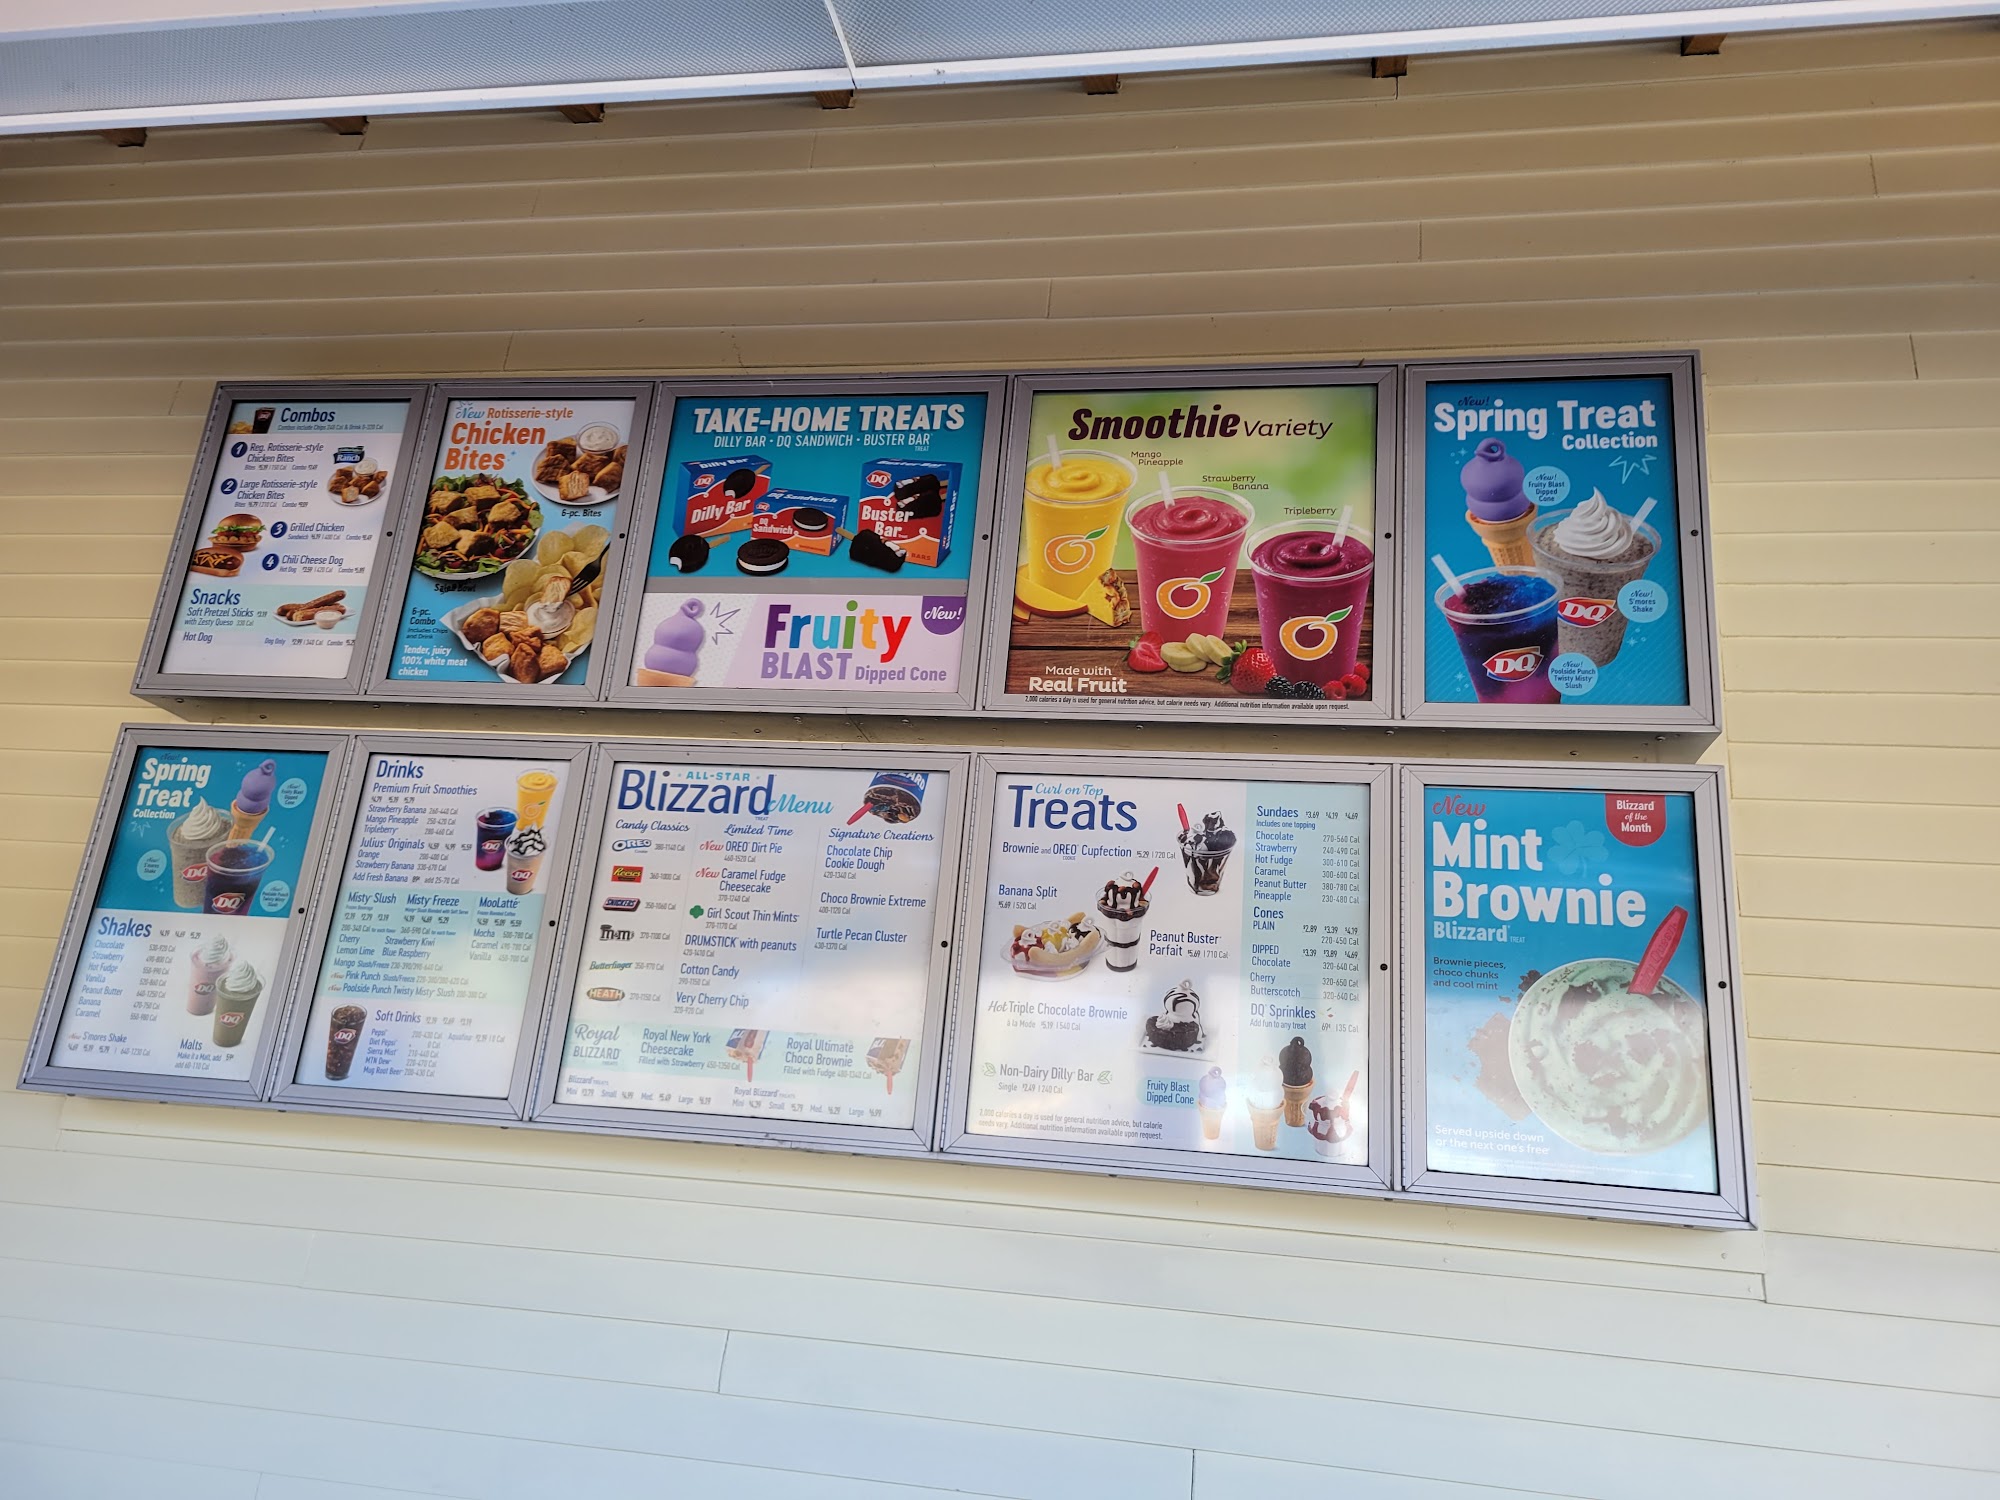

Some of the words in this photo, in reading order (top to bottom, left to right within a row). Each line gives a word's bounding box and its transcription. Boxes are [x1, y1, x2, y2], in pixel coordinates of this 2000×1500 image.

[281, 408, 335, 422] Combos
[456, 407, 485, 419] New
[487, 407, 573, 421] Rotisserie-style
[693, 405, 851, 433] TAKE-HOME
[859, 404, 965, 431] TREATS
[1434, 399, 1547, 440] Spring
[1557, 400, 1656, 430] Treat
[1068, 403, 1241, 440] Smoothie
[1244, 420, 1334, 440] Variety
[452, 421, 546, 445] Chicken
[714, 436, 740, 448] DILLY
[745, 436, 765, 448] BAR
[777, 436, 791, 448] DQ
[795, 435, 852, 447] SANDWICH
[864, 434, 905, 446] BUSTER
[908, 434, 930, 445] BAR
[1562, 431, 1658, 450] Collection
[250, 443, 266, 453] Reg.
[267, 443, 323, 453] Rotisserie-style
[444, 446, 505, 470] Bites
[700, 461, 726, 469] Dilly
[1138, 459, 1183, 467] Pineapple
[1202, 475, 1256, 483] Strawberry
[691, 505, 723, 524] Dilly
[725, 499, 751, 514] Bar
[862, 505, 914, 523] Buster
[1284, 507, 1337, 516] Tripleberry
[290, 523, 314, 531] Grilled
[316, 524, 344, 532] Chicken
[191, 588, 240, 605] Snacks
[187, 607, 202, 617] Soft
[204, 608, 230, 617] Pretzel
[232, 608, 253, 617] Sticks
[183, 632, 196, 642] Hot
[198, 632, 213, 643] Dog
[764, 600, 912, 663] Fruity
[761, 652, 852, 680] BLAST
[855, 666, 906, 684] Dipped
[909, 667, 947, 681] Cone
[1045, 666, 1078, 676] Made
[1083, 665, 1112, 676] with
[1029, 677, 1073, 692] Real
[1077, 677, 1126, 692] Fruit
[142, 757, 211, 788] Spring
[376, 760, 424, 779] Drinks
[136, 783, 194, 807] Treat
[373, 783, 409, 793] Premium
[412, 784, 431, 794] Fruit
[433, 785, 478, 796] Smoothies
[618, 770, 775, 815] Blizzard
[767, 794, 834, 815] Menu
[1036, 783, 1062, 794] Curl
[1065, 787, 1081, 795] on
[1083, 784, 1103, 798] Top
[368, 805, 401, 815] Strawberry
[403, 806, 426, 814] Banana
[1008, 785, 1138, 832] Treats
[1432, 795, 1486, 816] New
[1616, 800, 1654, 810] Blizzard
[133, 809, 175, 819] Collection
[1257, 806, 1298, 818] Sundaes
[1306, 811, 1319, 819] $3.69
[616, 819, 648, 833] Candy
[651, 821, 690, 832] Classics
[1621, 822, 1652, 832] Month
[829, 828, 881, 841] Signature
[883, 830, 935, 841] Creations
[1256, 831, 1294, 841] Chocolate
[1323, 835, 1348, 843] 270-560
[700, 840, 724, 850] New
[726, 841, 747, 852] OREO
[752, 842, 768, 852] Dirt
[769, 843, 782, 854] Pie
[1003, 842, 1039, 854] Brownie
[1053, 844, 1076, 854] OREO
[1082, 845, 1132, 858] Cupfection
[1255, 843, 1297, 854] Strawberry
[1323, 847, 1348, 855] 240-490
[1432, 819, 1542, 871] Mint
[827, 845, 871, 857] Chocolate
[874, 847, 893, 860] Chip
[825, 858, 854, 869] Cookie
[857, 859, 885, 872] Dough
[1254, 867, 1286, 876] Caramel
[721, 868, 757, 879] Caramel
[760, 870, 786, 883] Fudge
[720, 881, 771, 893] Cheesecake
[999, 884, 1033, 896] Banana
[1036, 886, 1057, 898] Split
[1254, 879, 1281, 889] Peanut
[1283, 880, 1307, 889] Butter
[407, 894, 430, 907] Misty
[432, 895, 459, 906] Freeze
[820, 892, 848, 904] Choco
[851, 894, 886, 906] Brownie
[888, 895, 926, 907] Extreme
[1254, 890, 1291, 901] Pineapple
[1433, 870, 1646, 928] Brownie
[1253, 907, 1284, 919] Cones
[98, 917, 152, 938] Shakes
[816, 928, 843, 939] Turtle
[845, 929, 872, 941] Pecan
[875, 930, 907, 942] Cluster
[1150, 930, 1185, 942] Peanut
[1187, 931, 1218, 944] Buster
[685, 935, 736, 948] DRUMSTICK
[740, 939, 758, 949] with
[760, 940, 797, 952] peanuts
[1150, 944, 1182, 956] Parfait
[1252, 944, 1279, 954] DIPPED
[681, 963, 710, 975] Cotton
[712, 965, 740, 979] Candy
[1434, 968, 1463, 978] choco
[1466, 969, 1498, 979] chunks
[82, 985, 104, 994] Peanut
[104, 987, 123, 996] Butter
[676, 992, 696, 1004] Very
[698, 993, 727, 1007] Cherry
[729, 994, 749, 1008] Chip
[375, 1010, 394, 1022] Soft
[396, 1011, 421, 1023] Drinks
[988, 1001, 1008, 1013] Hot
[1009, 1002, 1035, 1015] Triple
[1037, 1004, 1086, 1017] Chocolate
[1089, 1006, 1127, 1019] Brownie
[180, 1039, 202, 1050] Malts
[1147, 1080, 1168, 1093] Fruity
[1170, 1081, 1189, 1092] Blast
[1147, 1092, 1172, 1104] Dipped
[1175, 1094, 1194, 1105] Cone
[1436, 1124, 1472, 1136] Served
[1474, 1128, 1511, 1141] upside
[1513, 1131, 1544, 1142] down
